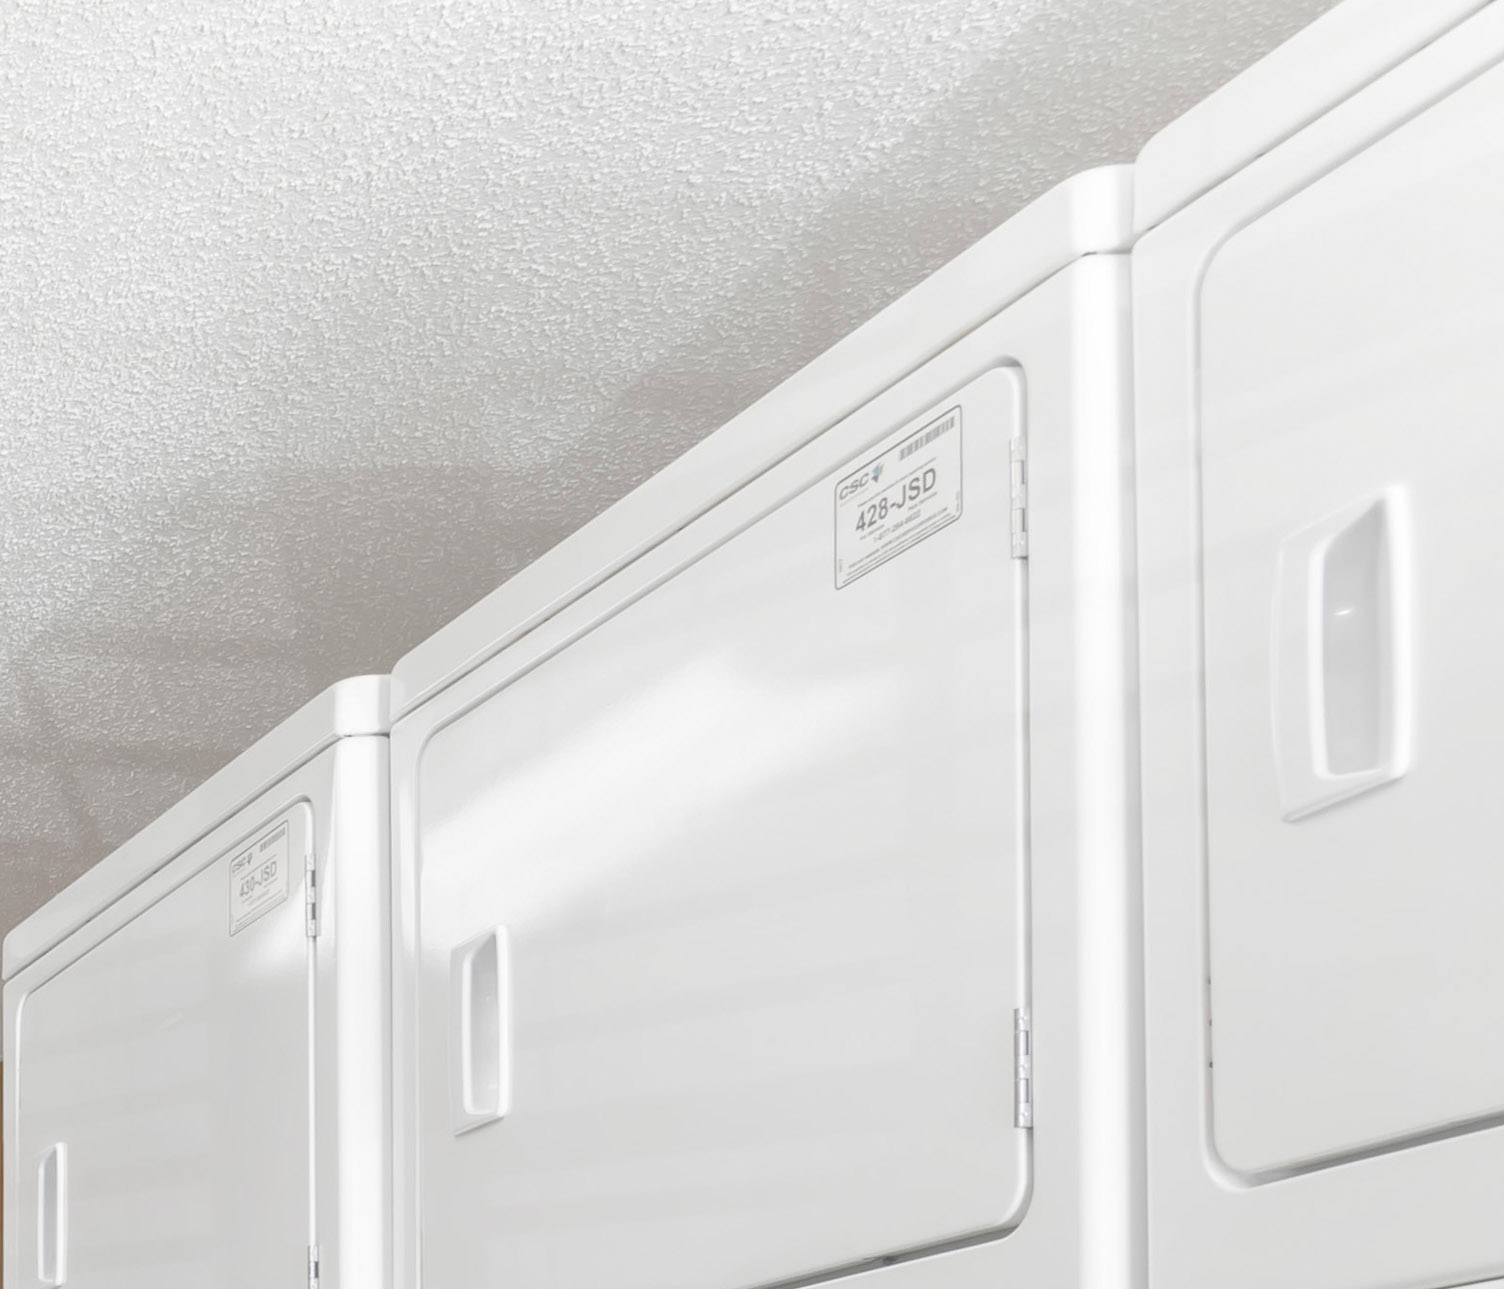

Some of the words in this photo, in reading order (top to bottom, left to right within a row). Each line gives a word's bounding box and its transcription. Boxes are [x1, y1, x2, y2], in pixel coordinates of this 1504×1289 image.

[840, 472, 870, 501] CSC
[855, 467, 937, 533] 428-JSD
[239, 860, 278, 897] 430-JSD
